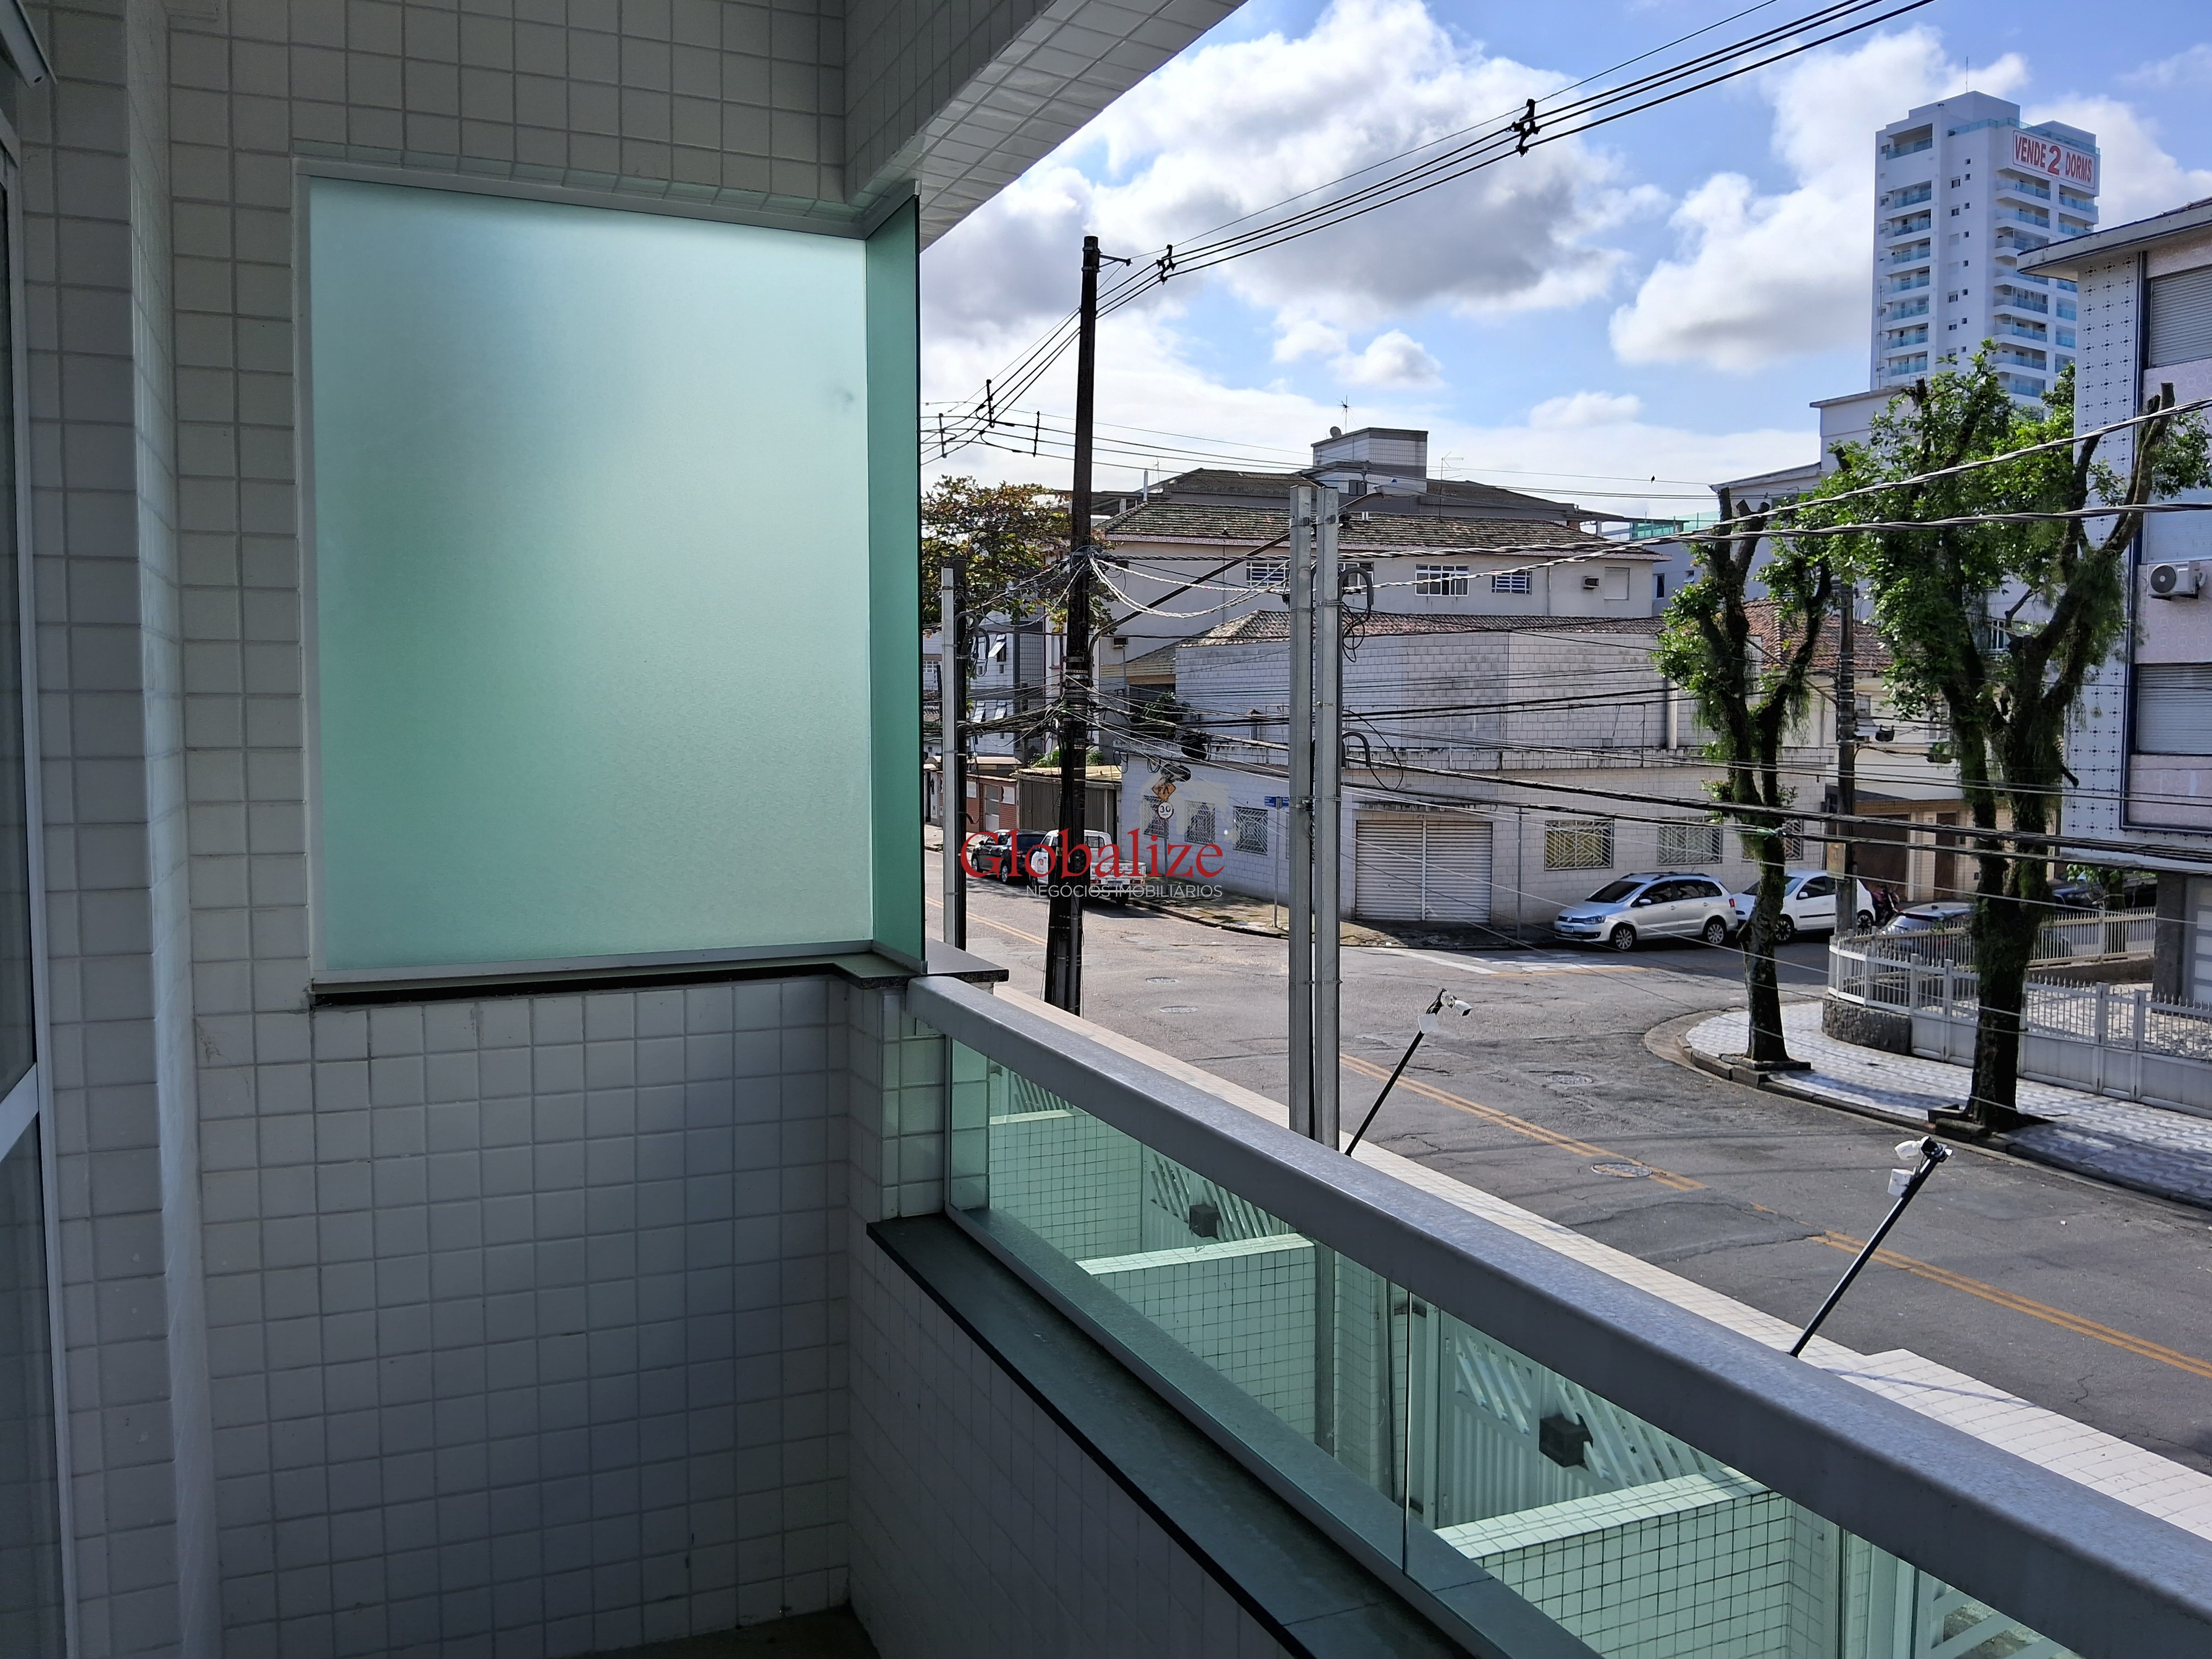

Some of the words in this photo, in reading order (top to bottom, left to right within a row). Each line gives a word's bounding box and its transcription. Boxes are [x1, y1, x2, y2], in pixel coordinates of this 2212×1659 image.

[2015, 135, 2047, 169] VENDE
[2047, 145, 2061, 175] 2
[2065, 152, 2092, 183] DORMS
